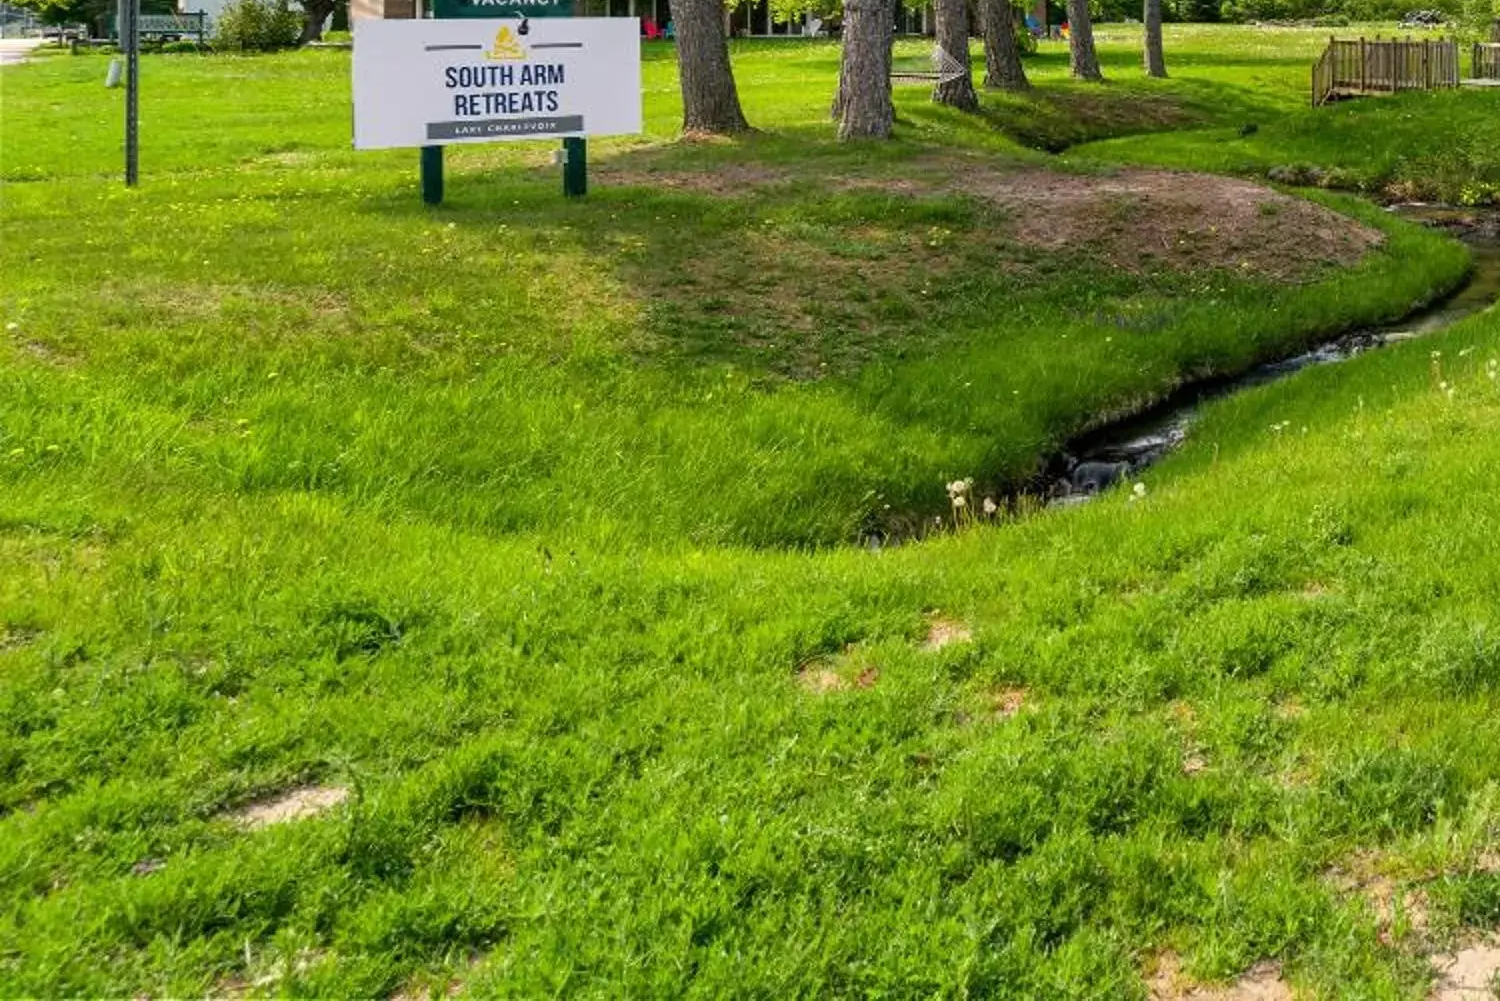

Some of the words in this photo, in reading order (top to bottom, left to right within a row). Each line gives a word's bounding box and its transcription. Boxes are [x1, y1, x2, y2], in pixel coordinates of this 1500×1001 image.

[445, 66, 513, 88] SOUTH
[520, 64, 564, 85] ARM
[455, 90, 558, 115] RETREATS
